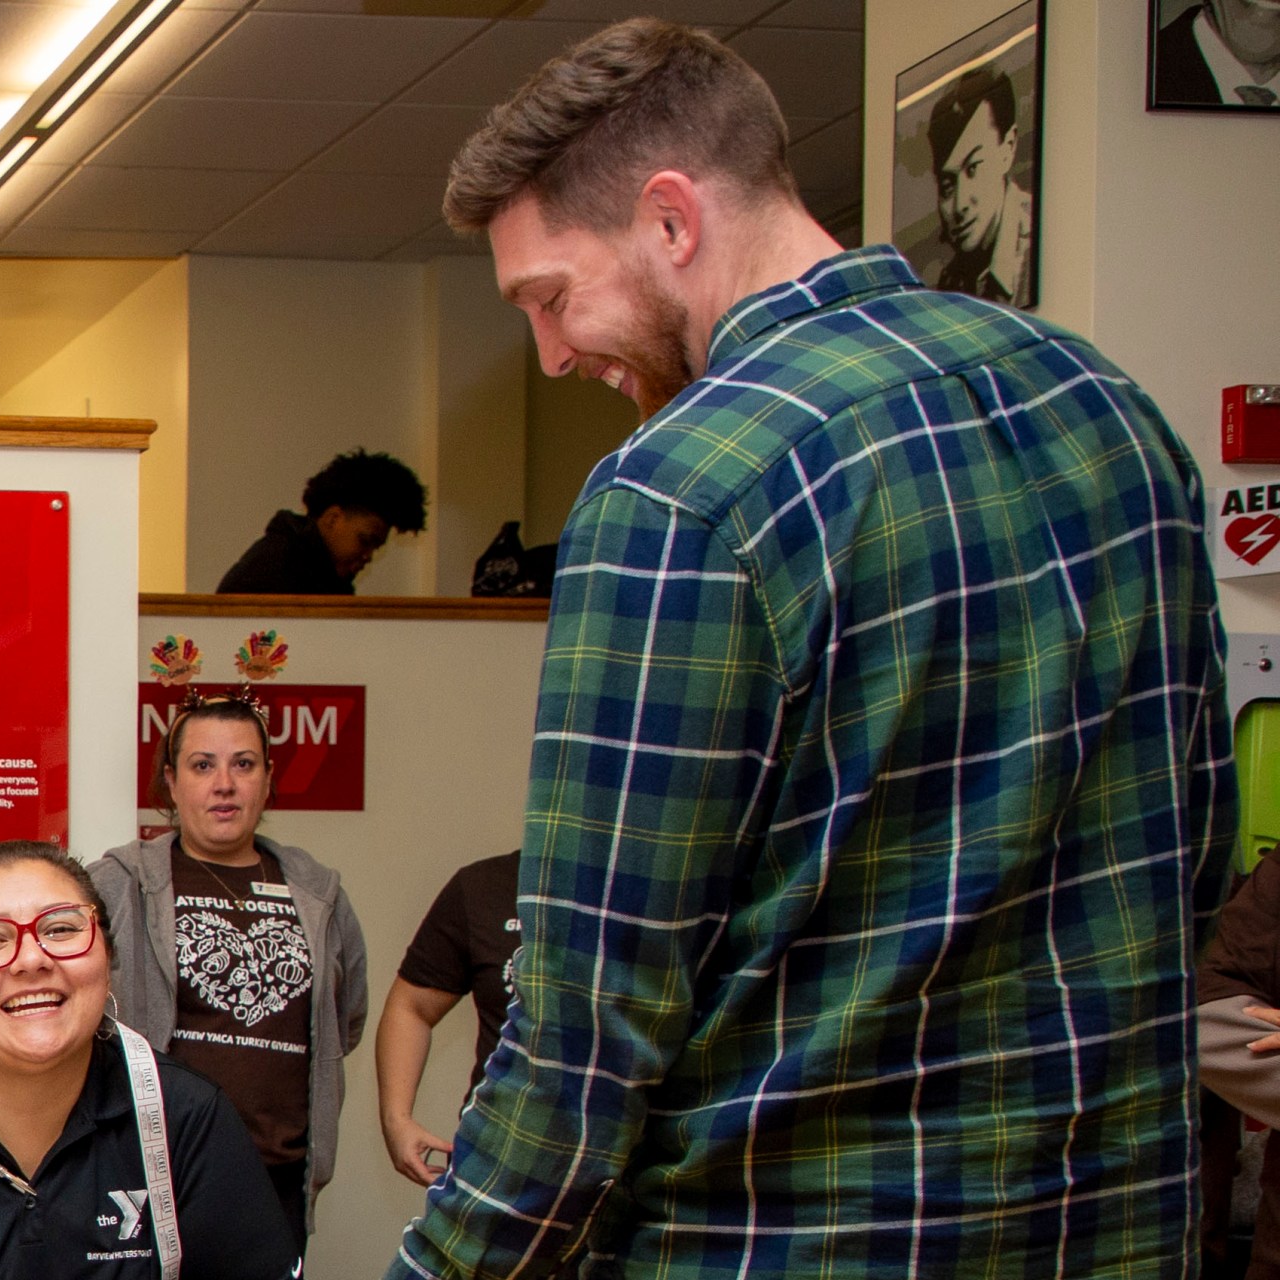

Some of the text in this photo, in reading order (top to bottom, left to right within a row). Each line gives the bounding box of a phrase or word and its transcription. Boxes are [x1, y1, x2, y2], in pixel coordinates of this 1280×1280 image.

[1221, 484, 1280, 516] AED
[0, 758, 37, 768] cause.
[6, 787, 38, 796] focused
[234, 900, 296, 915] OGETH
[207, 1032, 233, 1044] YMCA
[236, 1036, 270, 1049] TURKEY
[97, 1215, 118, 1226] the
